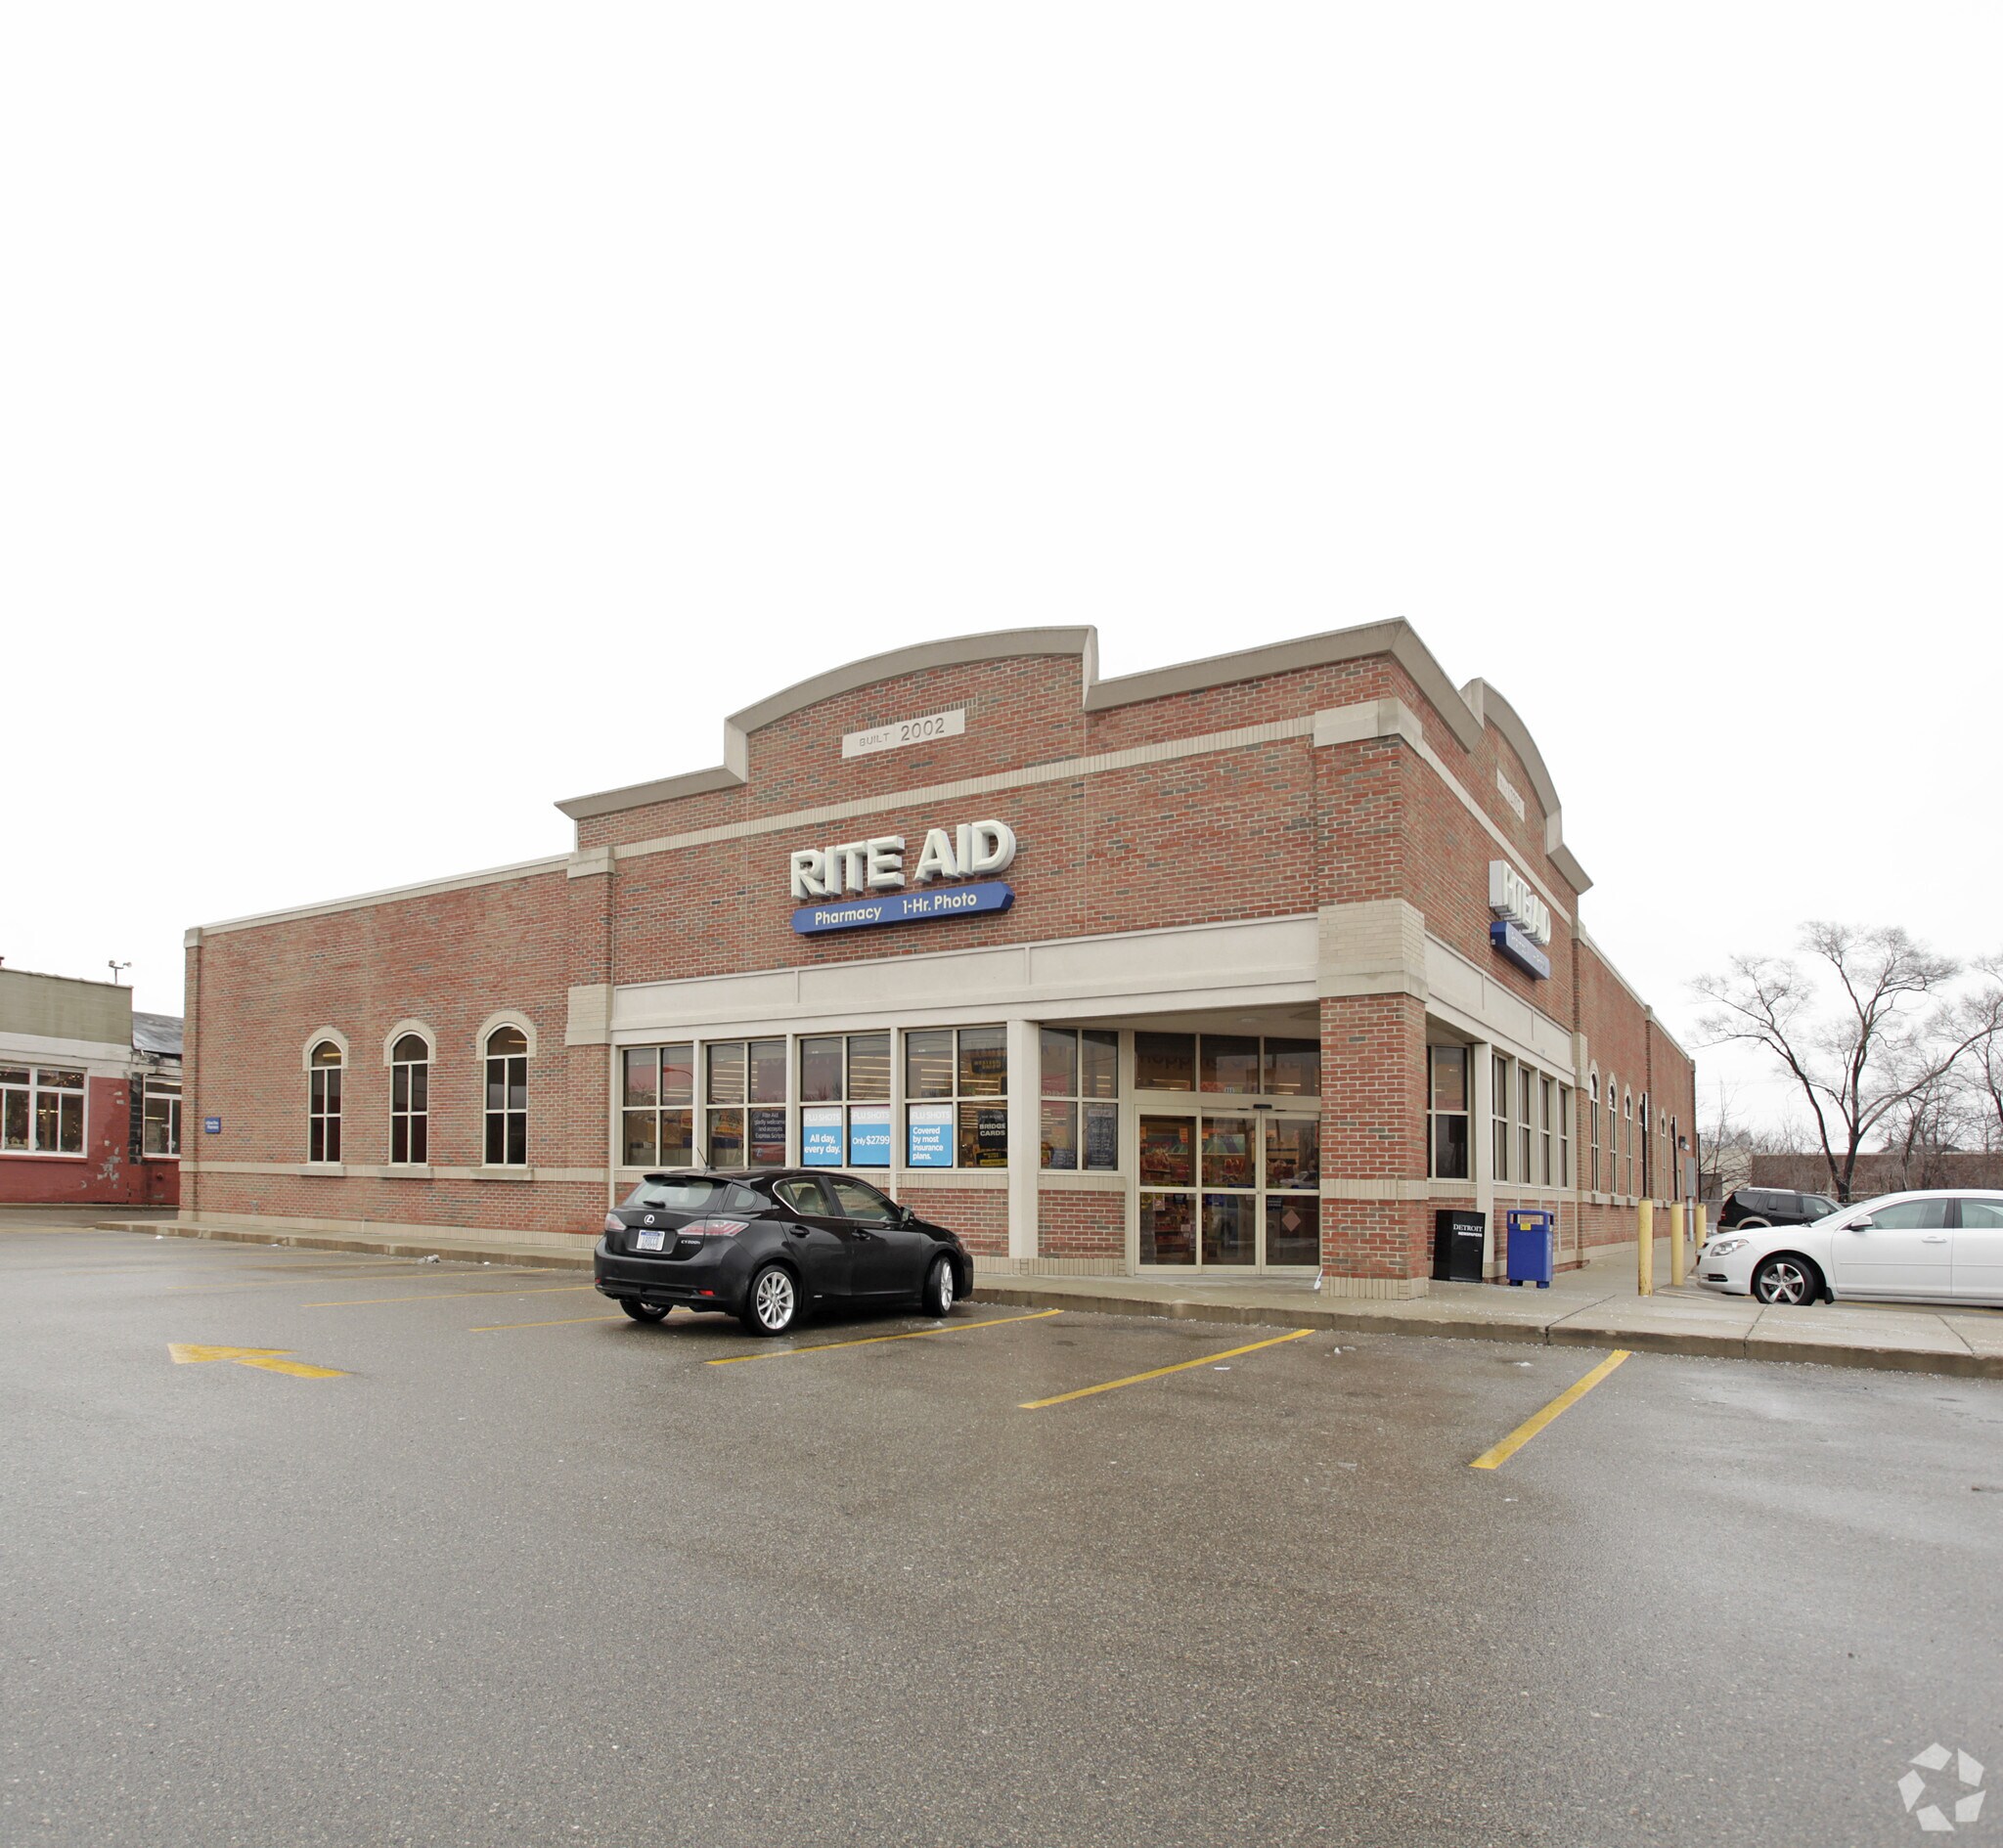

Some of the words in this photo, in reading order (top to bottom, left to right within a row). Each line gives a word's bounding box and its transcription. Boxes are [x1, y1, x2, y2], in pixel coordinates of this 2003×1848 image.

[860, 732, 890, 747] BUILT
[900, 717, 945, 741] 2002
[791, 834, 906, 900] RITE
[913, 819, 1017, 882] AID
[815, 906, 882, 926] Pharmacy
[903, 897, 931, 914] 1-Hr.
[934, 892, 977, 910] Photo
[819, 1113, 841, 1122] SHOTS
[853, 1111, 867, 1120] FLU
[912, 1111, 926, 1120] FLU
[927, 1111, 951, 1120] SHOTS
[912, 1126, 941, 1135] Covered
[810, 1133, 820, 1143] All
[821, 1133, 835, 1144] day,
[852, 1136, 867, 1147] Only
[912, 1135, 920, 1144] by
[804, 1145, 824, 1155] every
[912, 1152, 932, 1161] plans.
